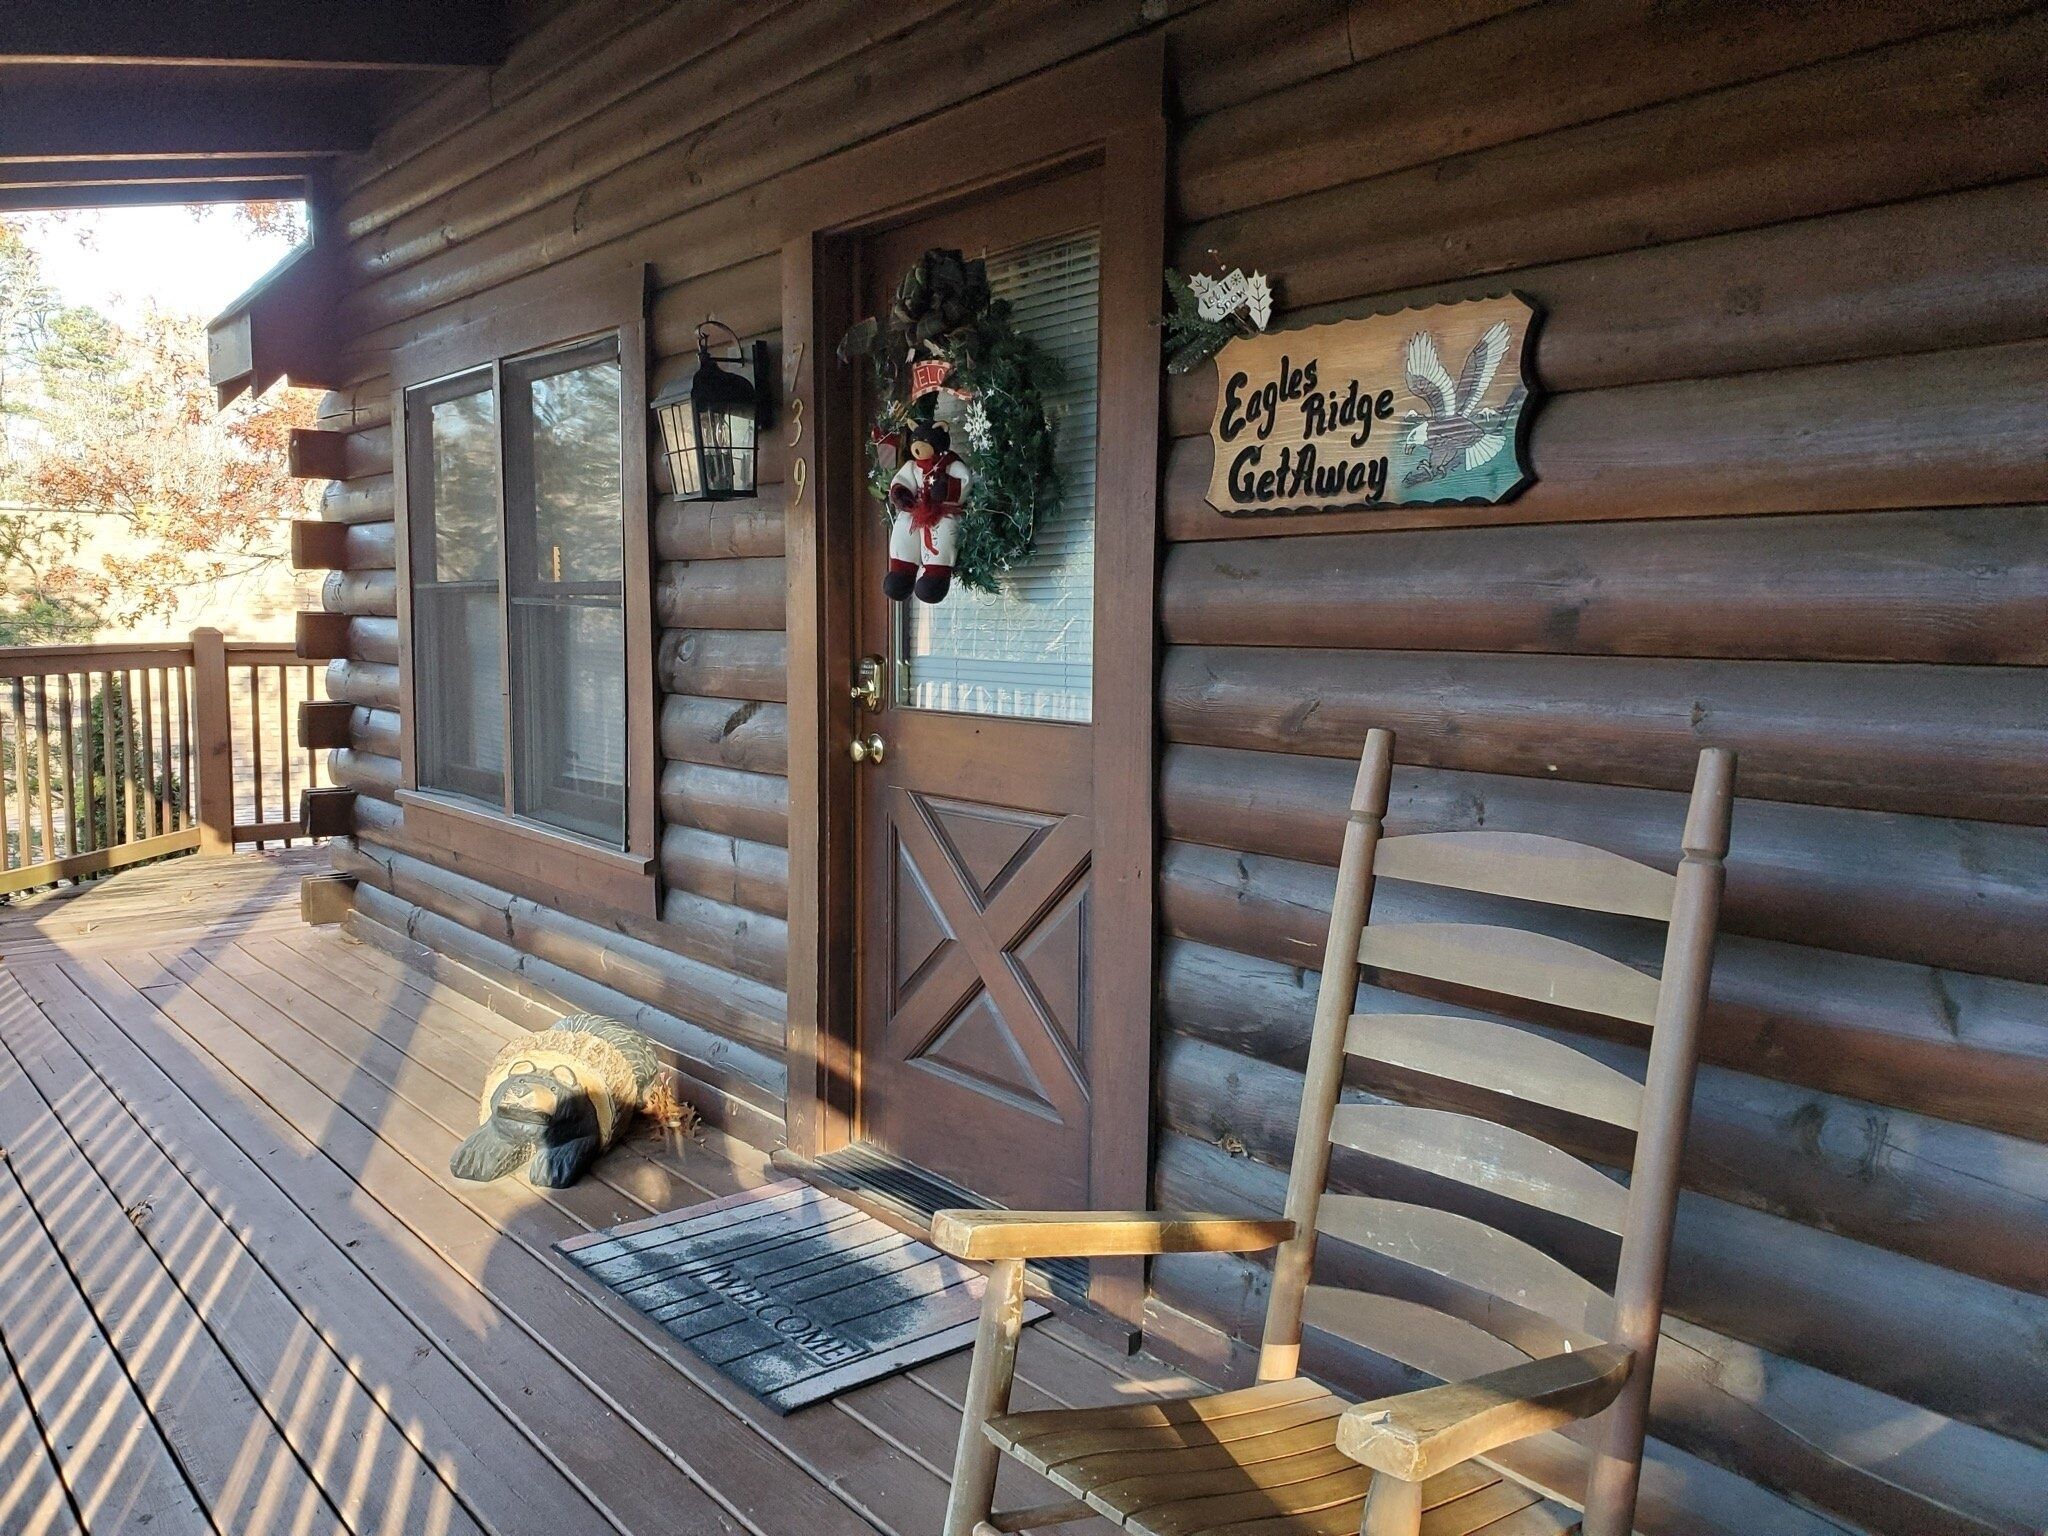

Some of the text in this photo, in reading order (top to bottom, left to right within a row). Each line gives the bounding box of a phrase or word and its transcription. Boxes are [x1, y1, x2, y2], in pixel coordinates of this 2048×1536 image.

[1219, 355, 1394, 448] Eagles Ridge
[1228, 444, 1389, 505] GetAway
[707, 1270, 860, 1362] WELCOME
